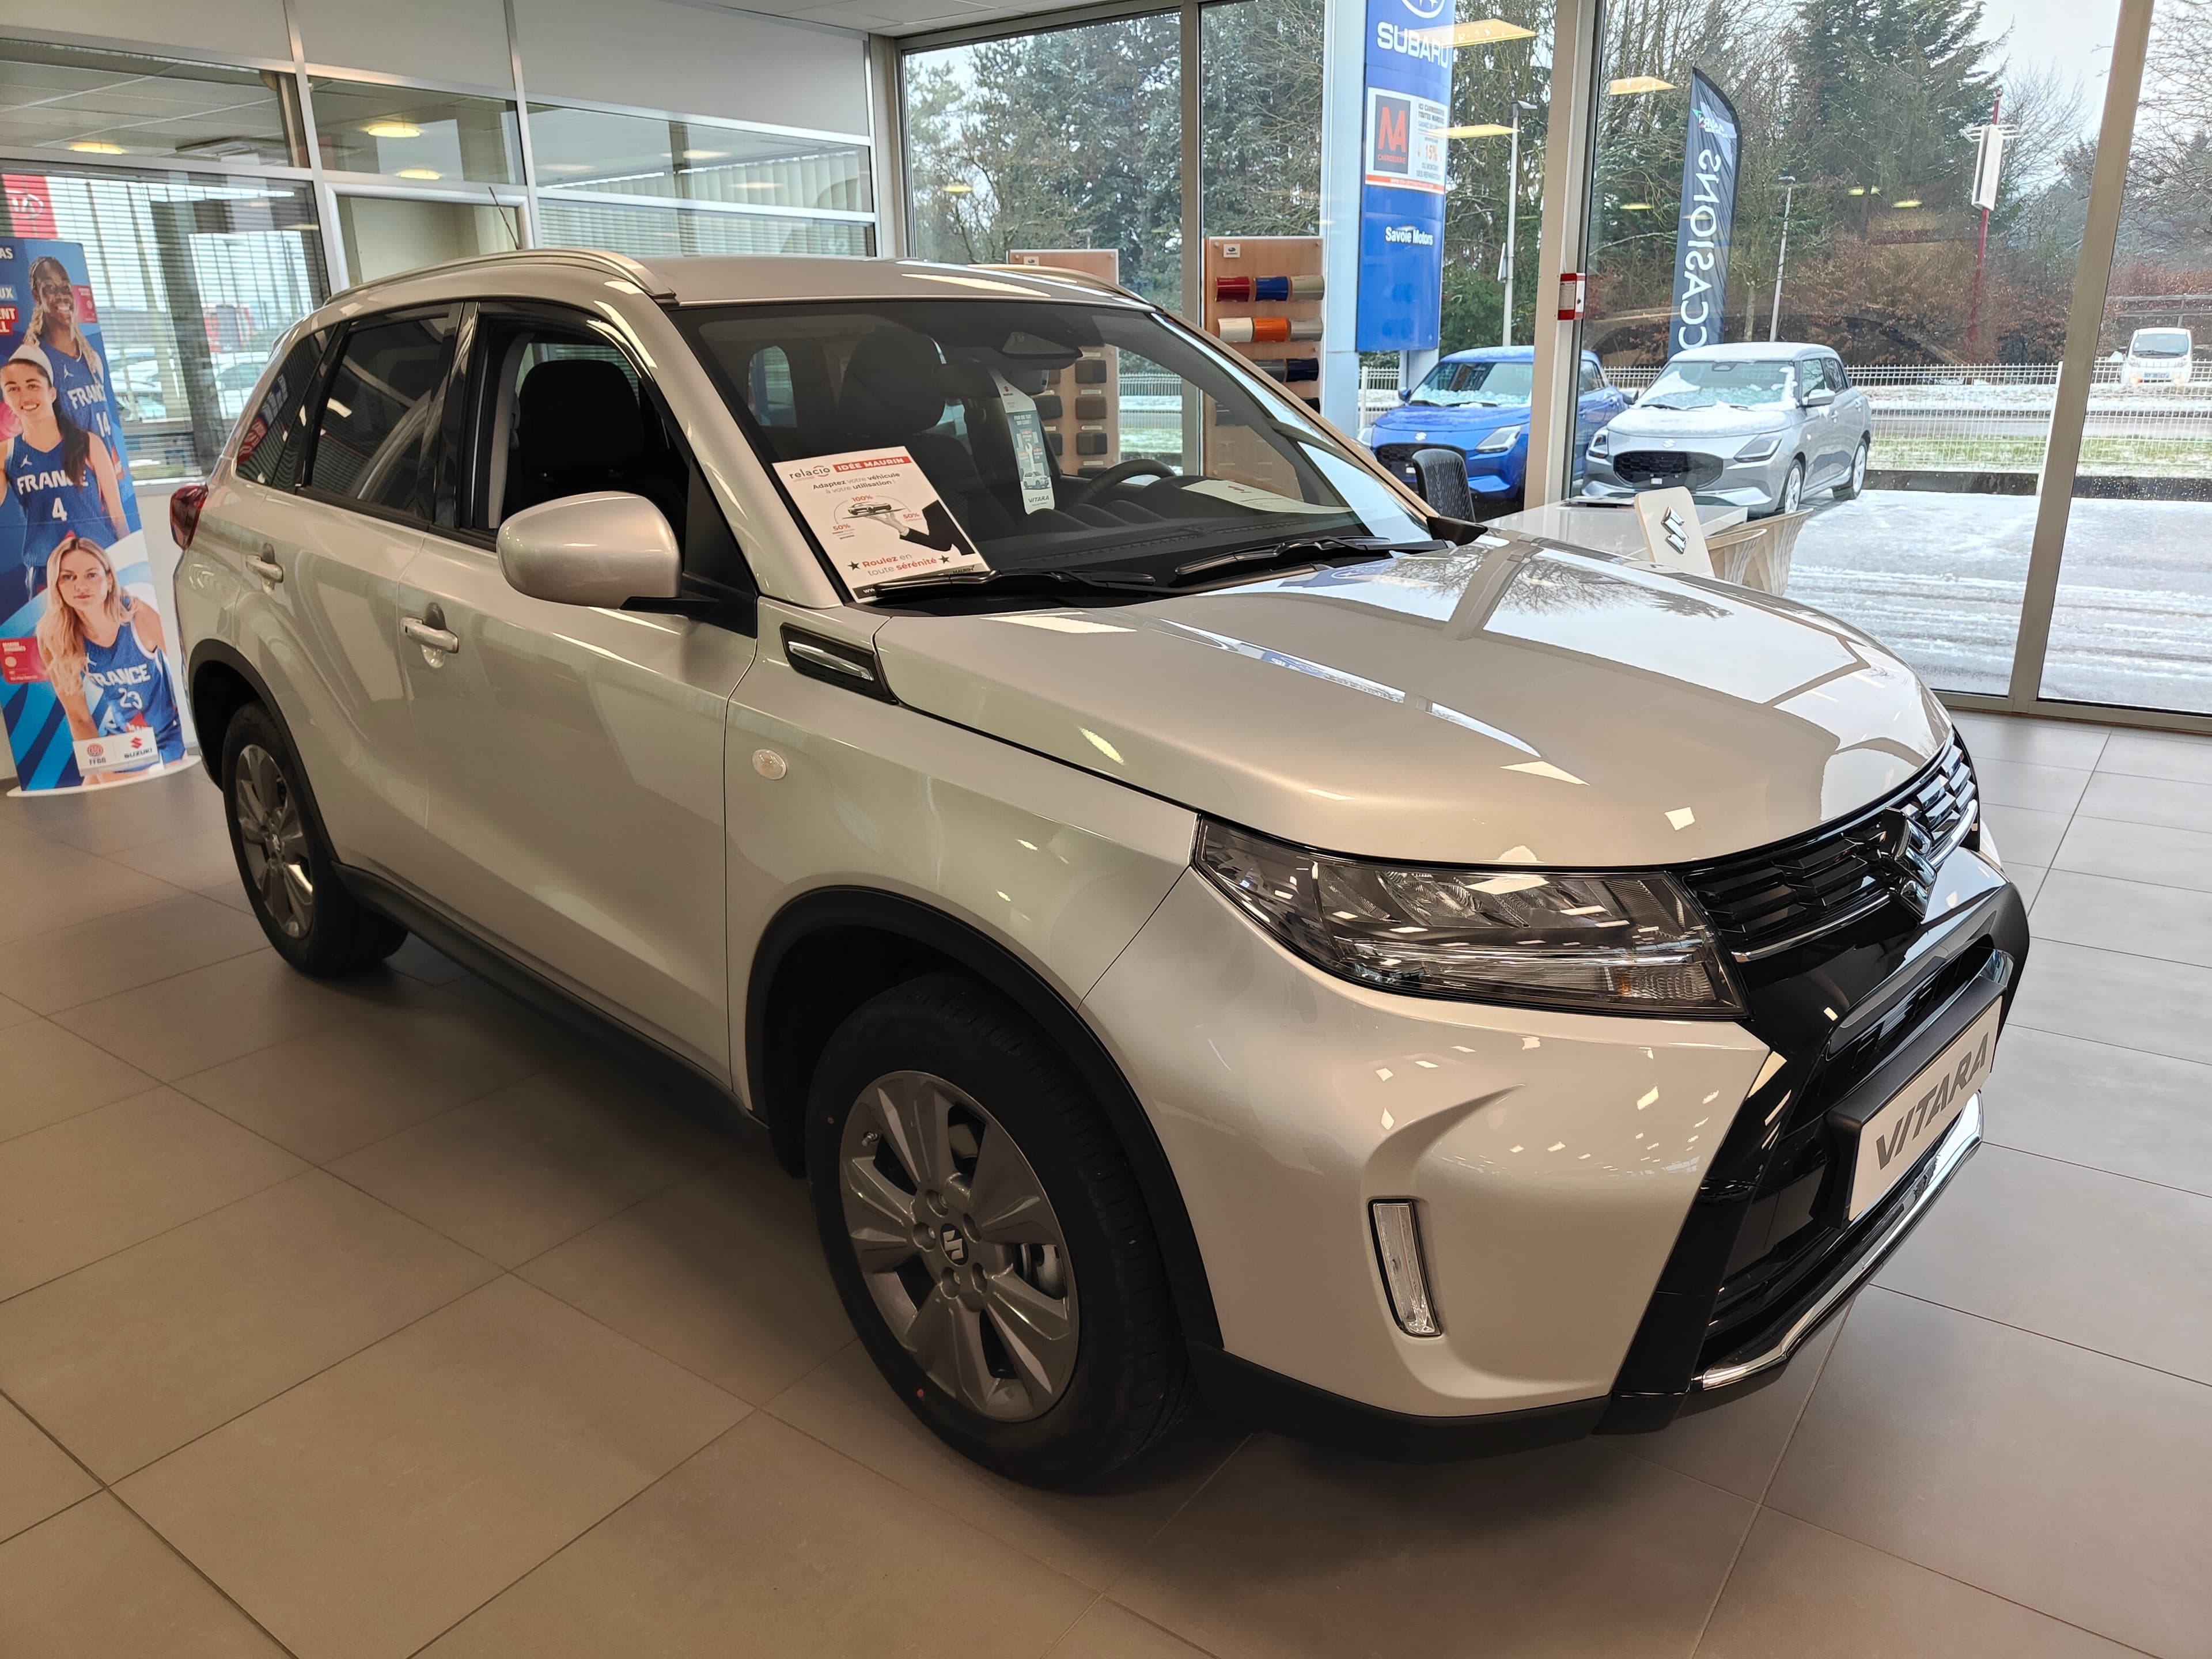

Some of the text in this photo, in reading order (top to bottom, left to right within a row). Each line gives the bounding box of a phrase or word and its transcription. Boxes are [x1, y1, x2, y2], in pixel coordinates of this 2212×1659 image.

[1377, 21, 1449, 69] SUBARU
[1385, 226, 1433, 246] Savoie Motors
[96, 411, 111, 438] 14
[789, 467, 830, 479] relacio
[836, 458, 904, 472] IDÉE MAURIN
[813, 479, 846, 490] Adaptez
[867, 472, 900, 481] véhicule
[853, 479, 892, 490] utilisation
[851, 494, 873, 502] 100%
[52, 497, 67, 521] 4
[832, 523, 851, 531] 50%
[862, 555, 899, 569] Roulez
[868, 557, 937, 577] toute sérénité
[89, 663, 151, 688] RANCE
[118, 687, 143, 710] 23
[1876, 1031, 1988, 1171] VITARA
